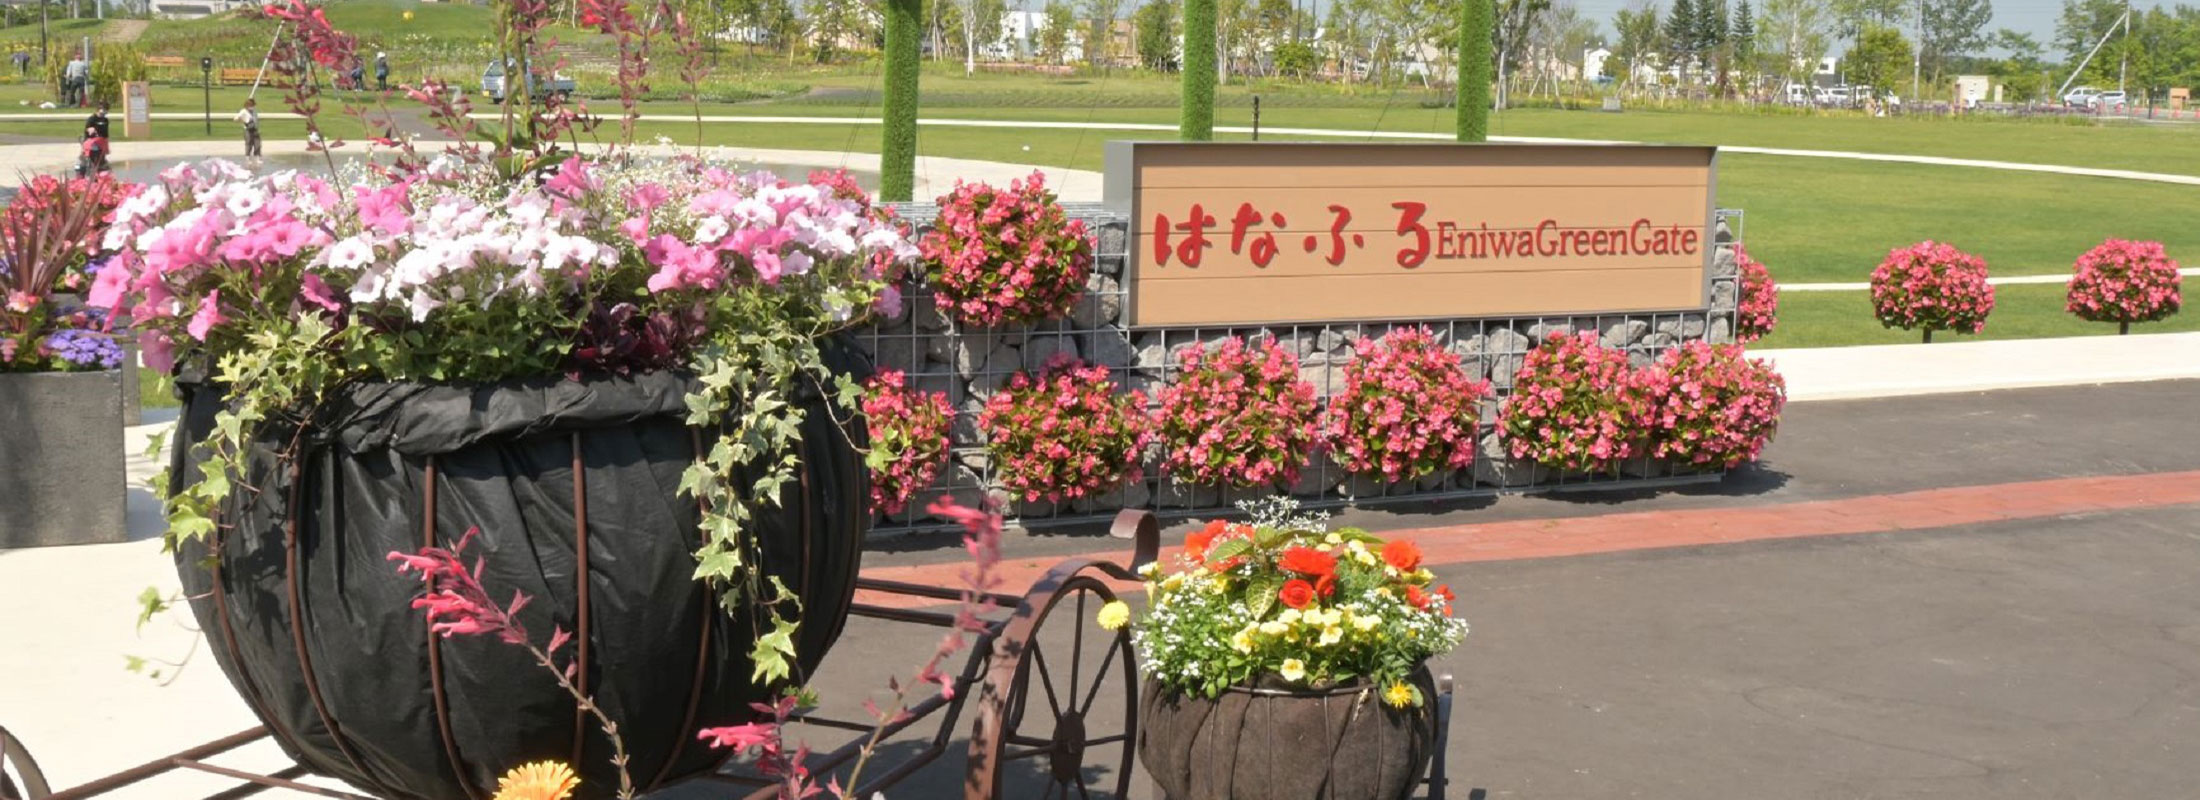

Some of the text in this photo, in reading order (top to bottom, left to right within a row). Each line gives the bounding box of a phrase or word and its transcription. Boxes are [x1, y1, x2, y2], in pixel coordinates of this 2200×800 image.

[1153, 202, 1698, 267] はなふる EniwaGreenGate
